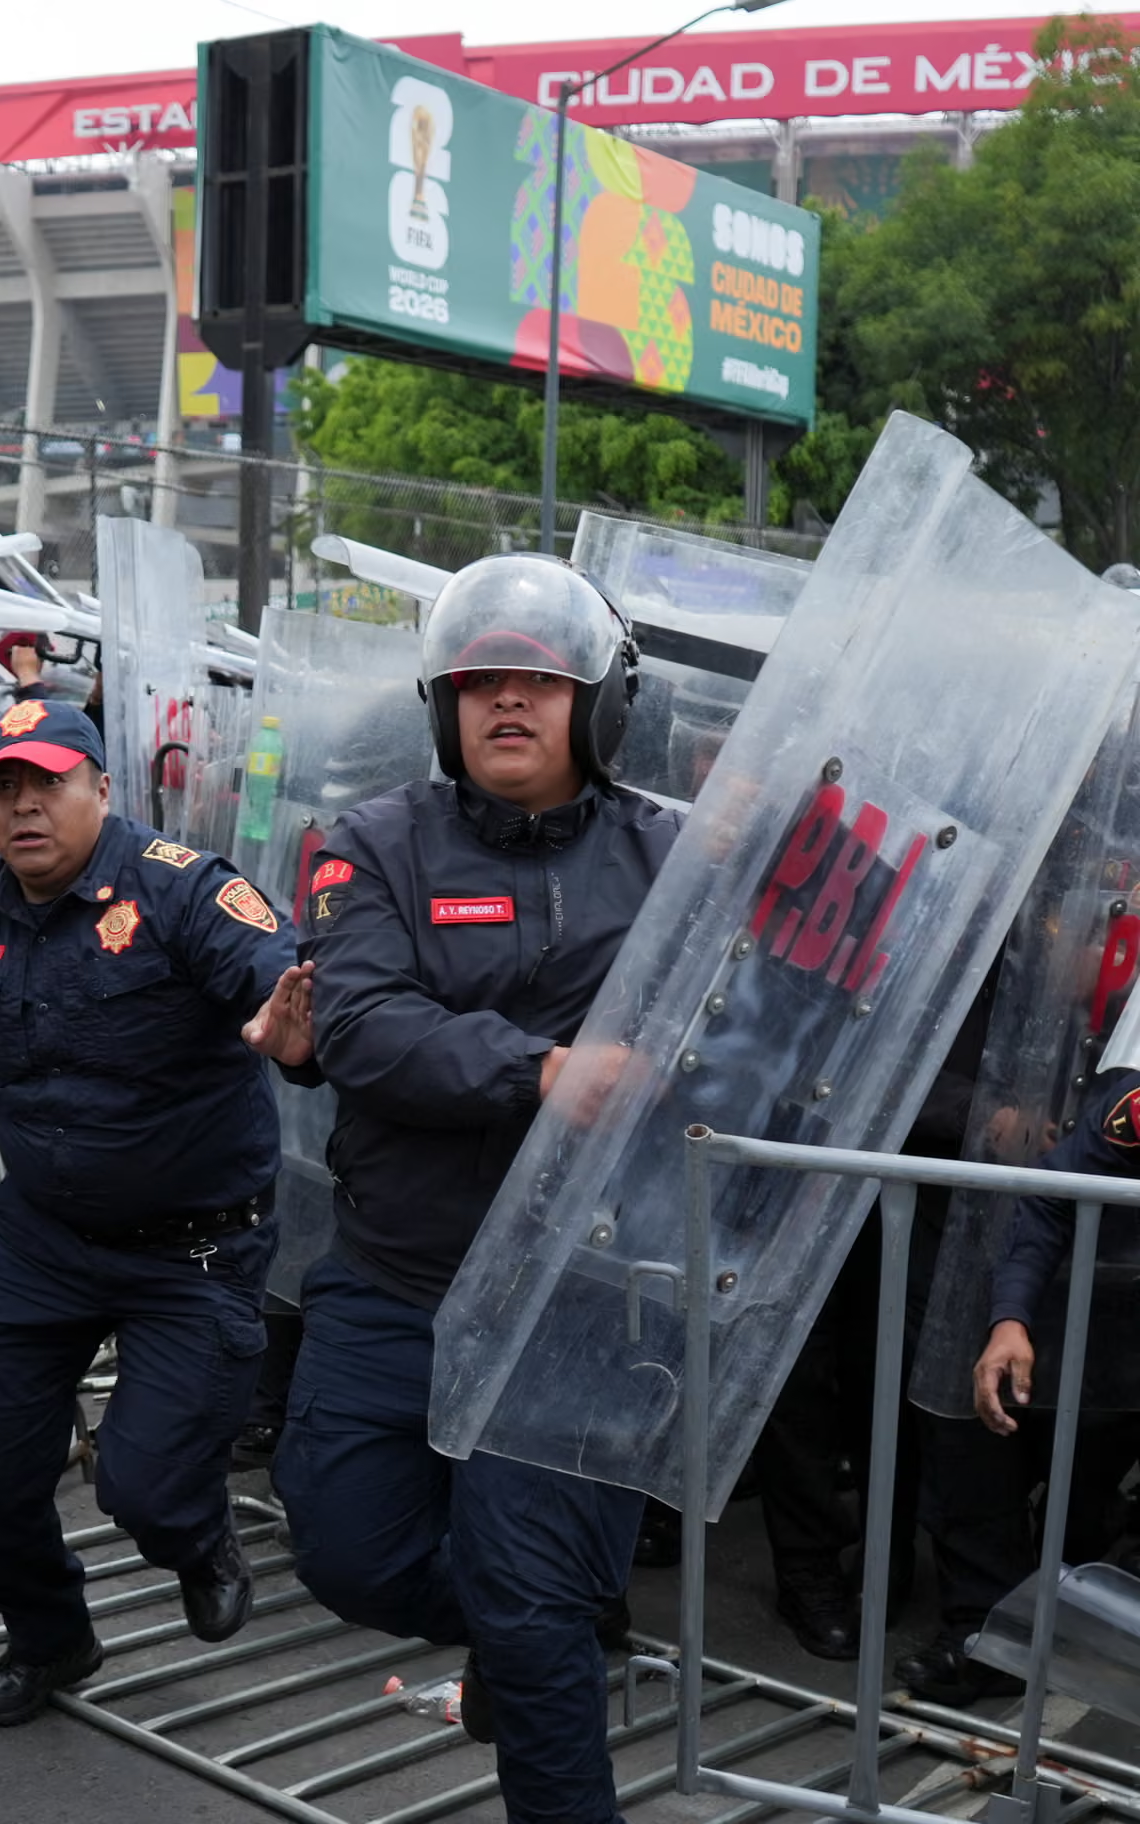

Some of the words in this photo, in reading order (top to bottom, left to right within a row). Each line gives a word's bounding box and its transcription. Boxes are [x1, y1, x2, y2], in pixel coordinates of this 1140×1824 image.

[538, 63, 774, 107] CIUDAD
[805, 56, 891, 97] DE
[712, 203, 805, 277] SOMOS
[388, 284, 450, 324] 2026
[712, 261, 779, 310] CIUDAD
[780, 282, 804, 318] DE
[710, 299, 803, 353] MÉXICO
[316, 891, 332, 919] K
[752, 783, 928, 992] P.B.I.
